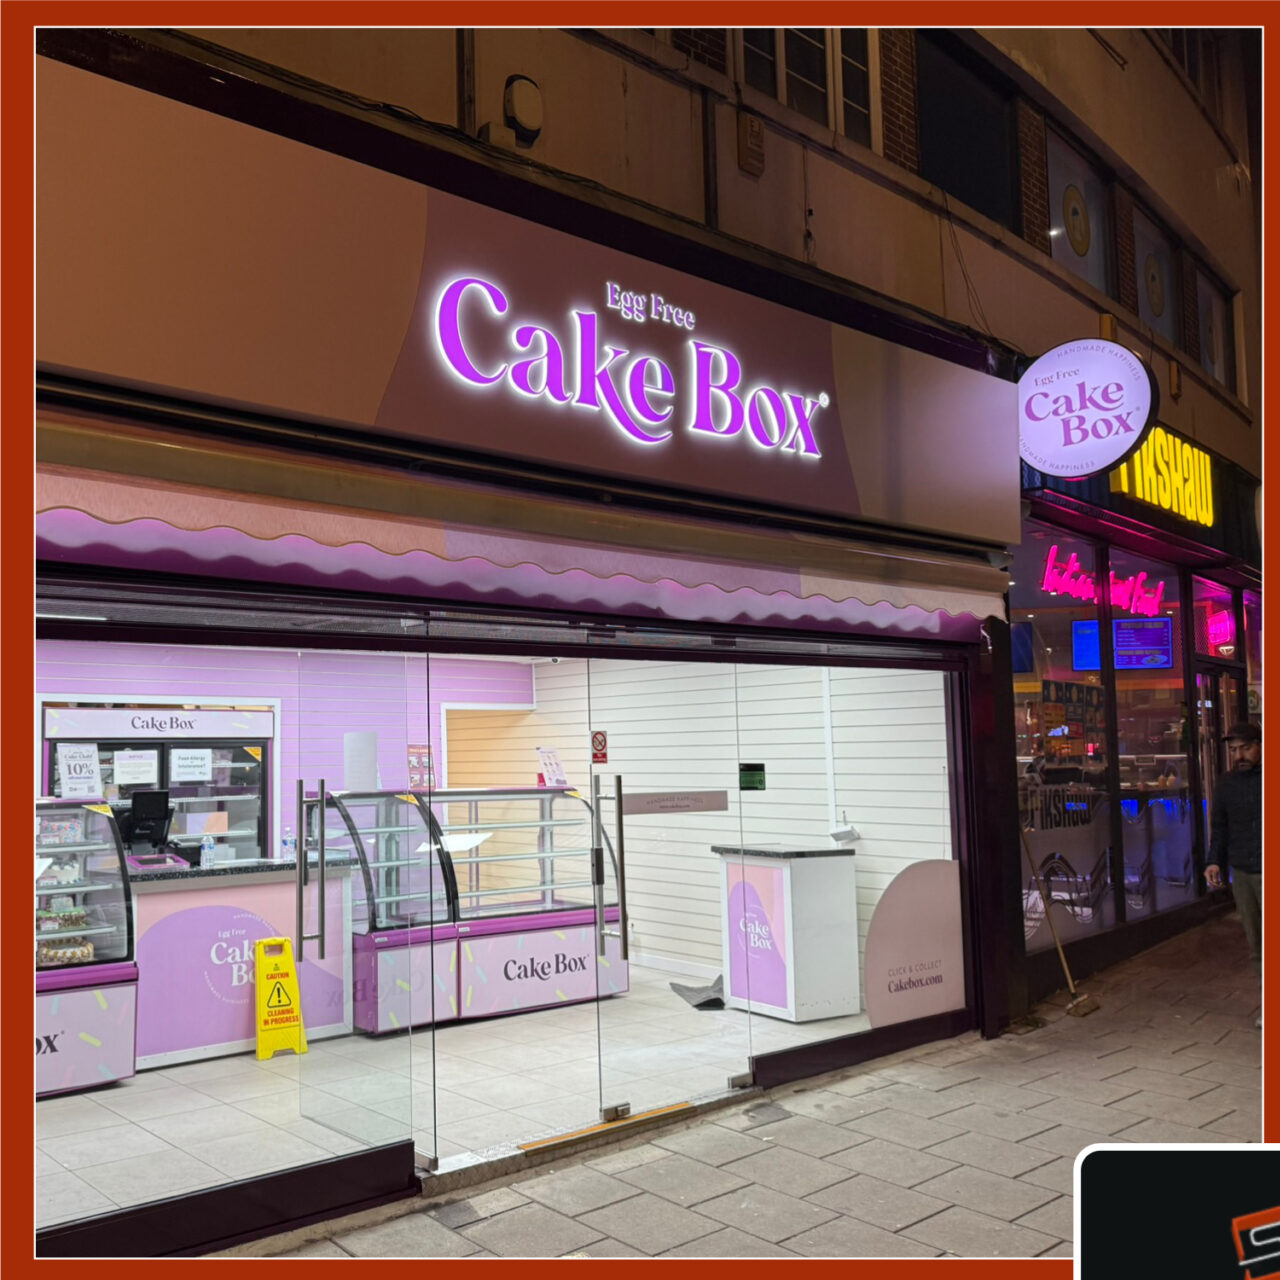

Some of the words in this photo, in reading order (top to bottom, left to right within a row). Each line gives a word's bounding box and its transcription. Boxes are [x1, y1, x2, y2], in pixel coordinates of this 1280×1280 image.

[606, 281, 648, 323] Egg
[650, 292, 697, 330] Free
[434, 275, 676, 445] Cake
[688, 339, 823, 458] Box
[1057, 345, 1107, 359] HANDMADE
[1108, 348, 1142, 383] HAPPINESS
[1034, 374, 1055, 387] Egg
[1056, 368, 1080, 382] Free
[1024, 380, 1125, 422] Cake
[1060, 411, 1136, 447] Box
[1048, 460, 1096, 472] HAPPINESS
[131, 715, 168, 732] Cake
[169, 716, 195, 730] Box
[67, 762, 94, 776] 10%
[739, 919, 770, 938] Cake
[750, 933, 772, 950] Box
[210, 940, 256, 965] Cak
[504, 958, 552, 984] Cake
[554, 952, 587, 976] Box
[915, 959, 943, 972] COLLECT
[266, 972, 290, 981] CAUTION
[888, 973, 943, 994] Cakebox.com
[267, 1007, 295, 1018] CLEANING
[270, 1015, 300, 1026] PROGRESS
